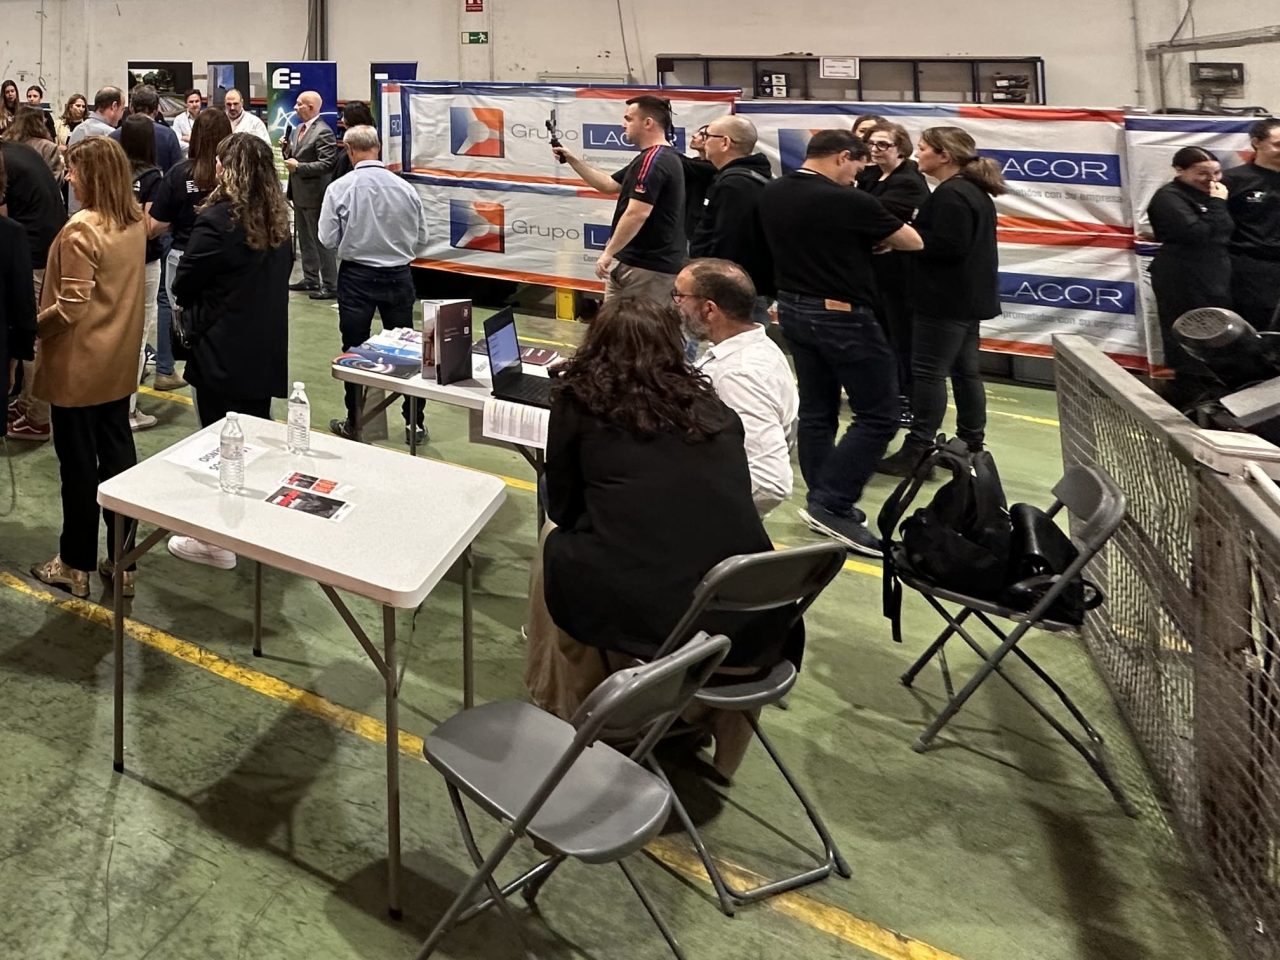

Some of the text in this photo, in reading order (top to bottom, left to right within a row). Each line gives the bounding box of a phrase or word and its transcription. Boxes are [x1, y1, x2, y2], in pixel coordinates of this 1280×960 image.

[1001, 157, 1109, 180] ACOR
[511, 219, 580, 241] Grupo
[1000, 281, 1124, 309] ACOR
